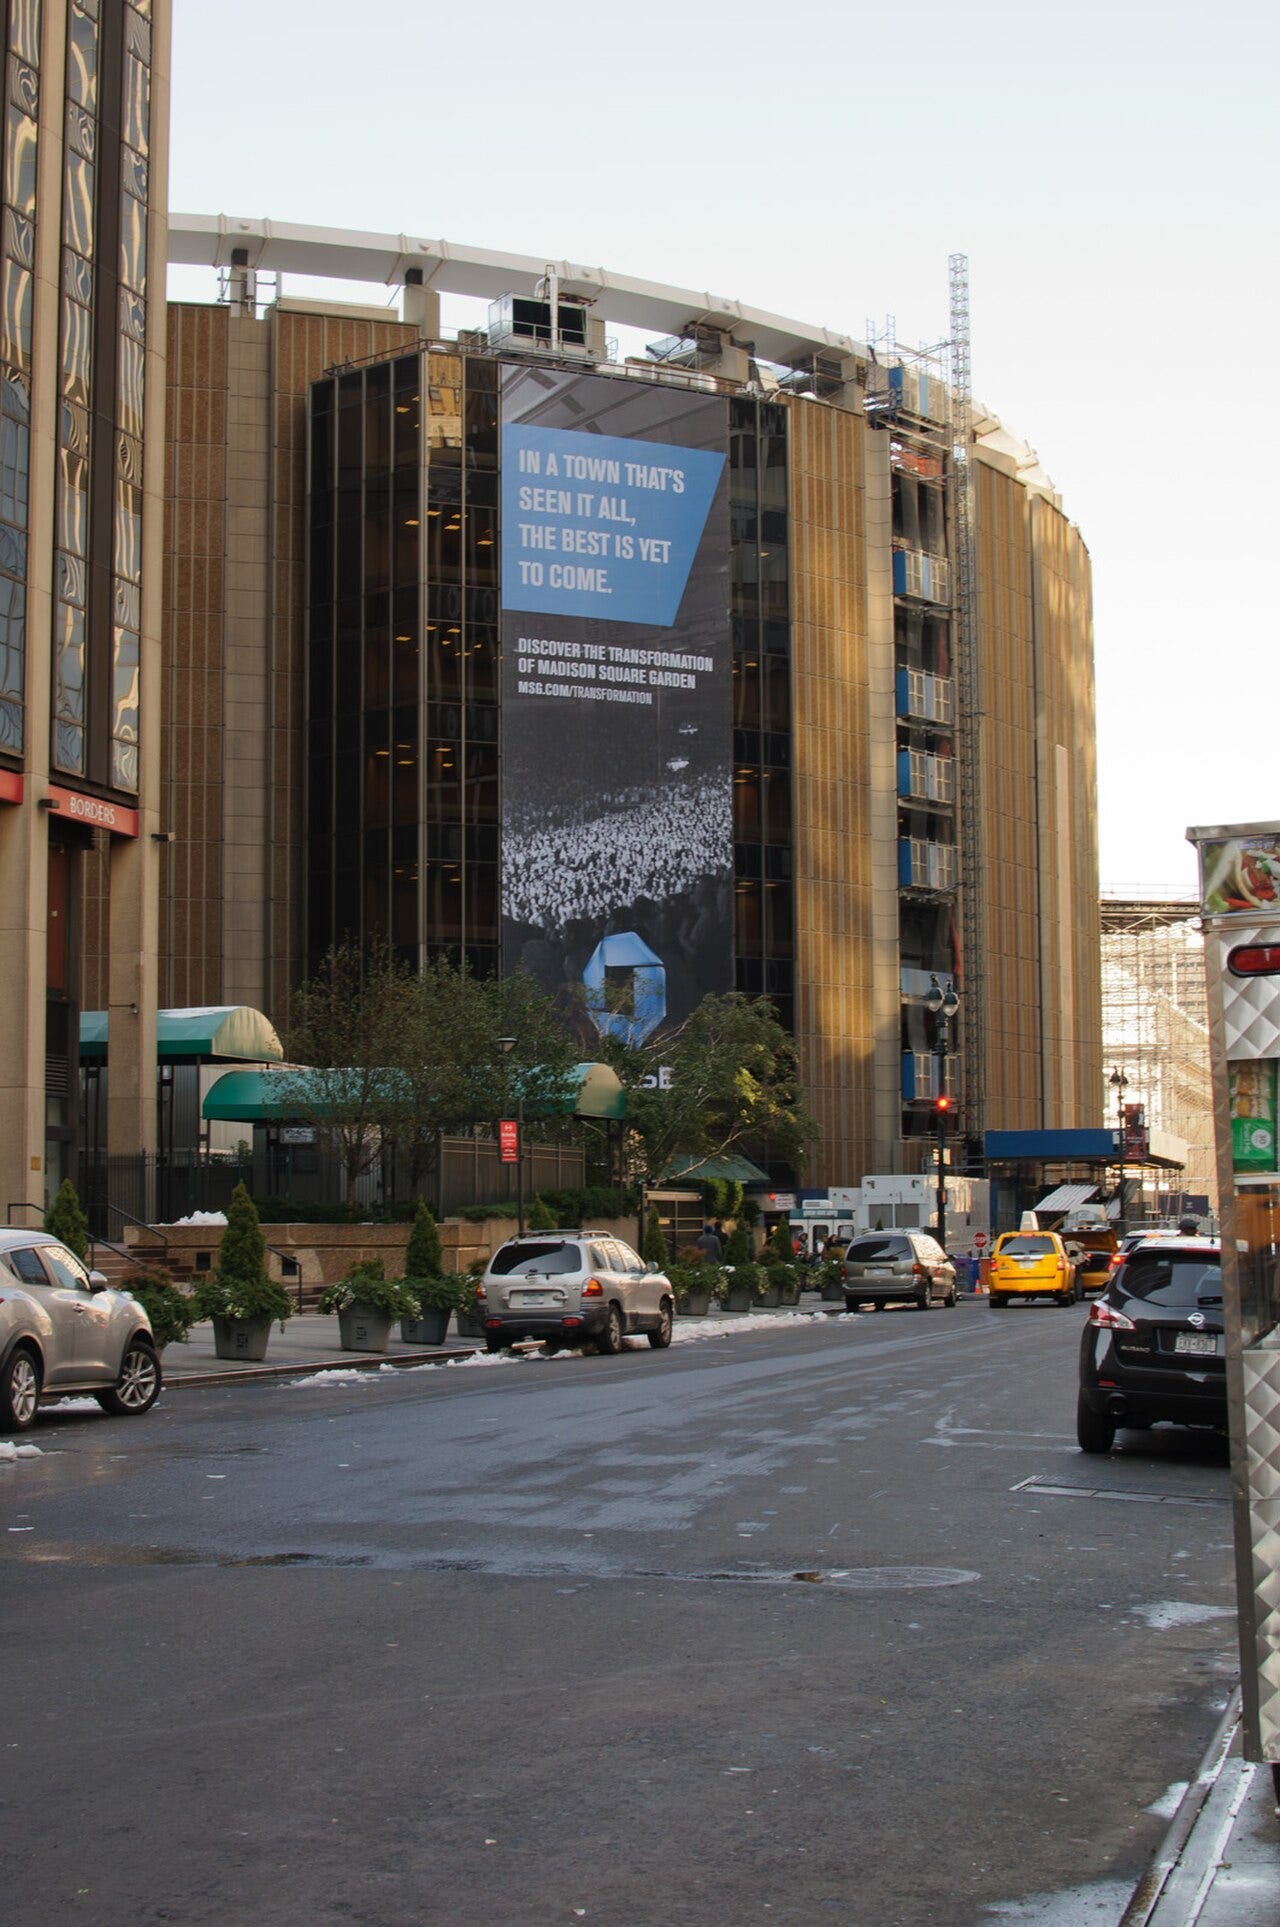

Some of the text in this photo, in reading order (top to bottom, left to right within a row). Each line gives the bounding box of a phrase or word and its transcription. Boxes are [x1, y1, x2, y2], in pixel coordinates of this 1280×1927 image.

[519, 449, 685, 494] IN A TOWN THAT'S
[519, 486, 636, 527] SEEN IT ALL,
[518, 523, 672, 564] THE BEST IS YET
[518, 561, 612, 594] TO COME.
[518, 637, 714, 672] DISCOVER THE TRANSFORMATION
[518, 657, 697, 690] OF MADISON SQUARE GARDEN
[518, 680, 653, 705] MSG.COM/TRANSFORMATION
[70, 797, 115, 824] BORDERS
